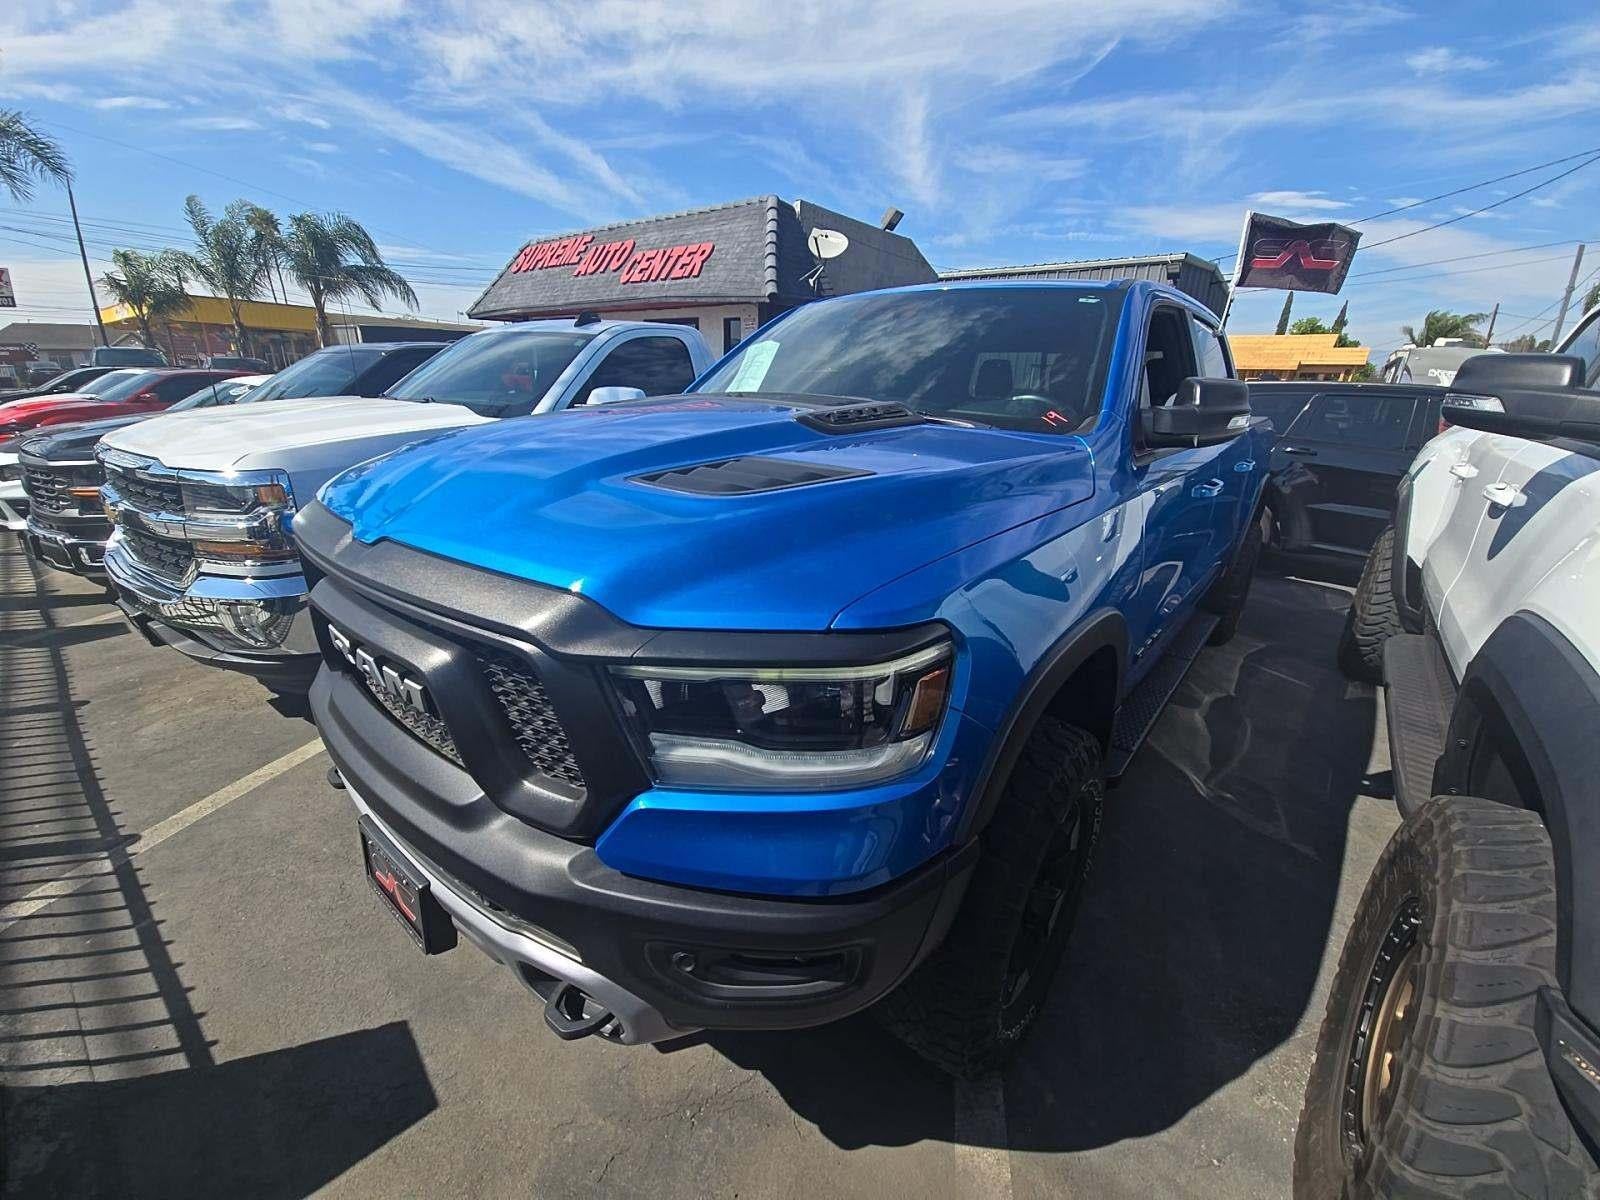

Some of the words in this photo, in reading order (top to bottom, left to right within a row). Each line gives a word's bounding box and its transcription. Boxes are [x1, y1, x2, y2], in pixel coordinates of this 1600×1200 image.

[511, 235, 595, 273] SUPREME
[573, 239, 636, 277] AUTO
[620, 242, 716, 284] CENTER
[328, 623, 425, 714] RAM
